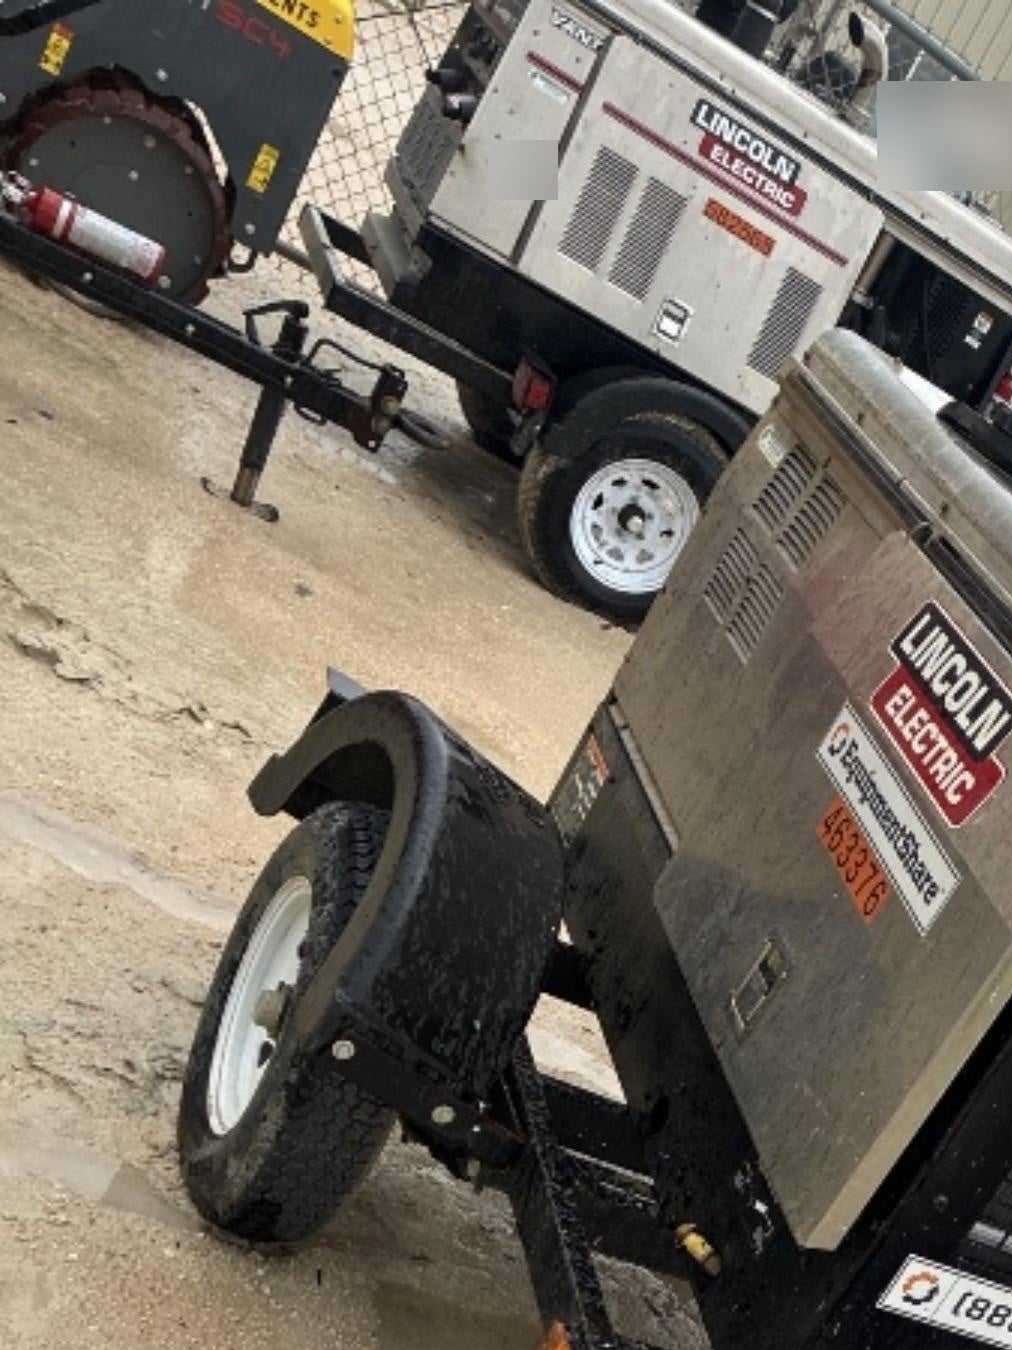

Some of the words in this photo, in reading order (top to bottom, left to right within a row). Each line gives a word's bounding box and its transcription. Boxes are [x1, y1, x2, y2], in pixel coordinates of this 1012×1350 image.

[696, 104, 796, 182] LINCOLN
[709, 144, 797, 208] ELECTRIC
[900, 613, 1012, 751] LINCOLN
[884, 683, 976, 805] ELECTRIC
[840, 740, 940, 904] EquipmentShare
